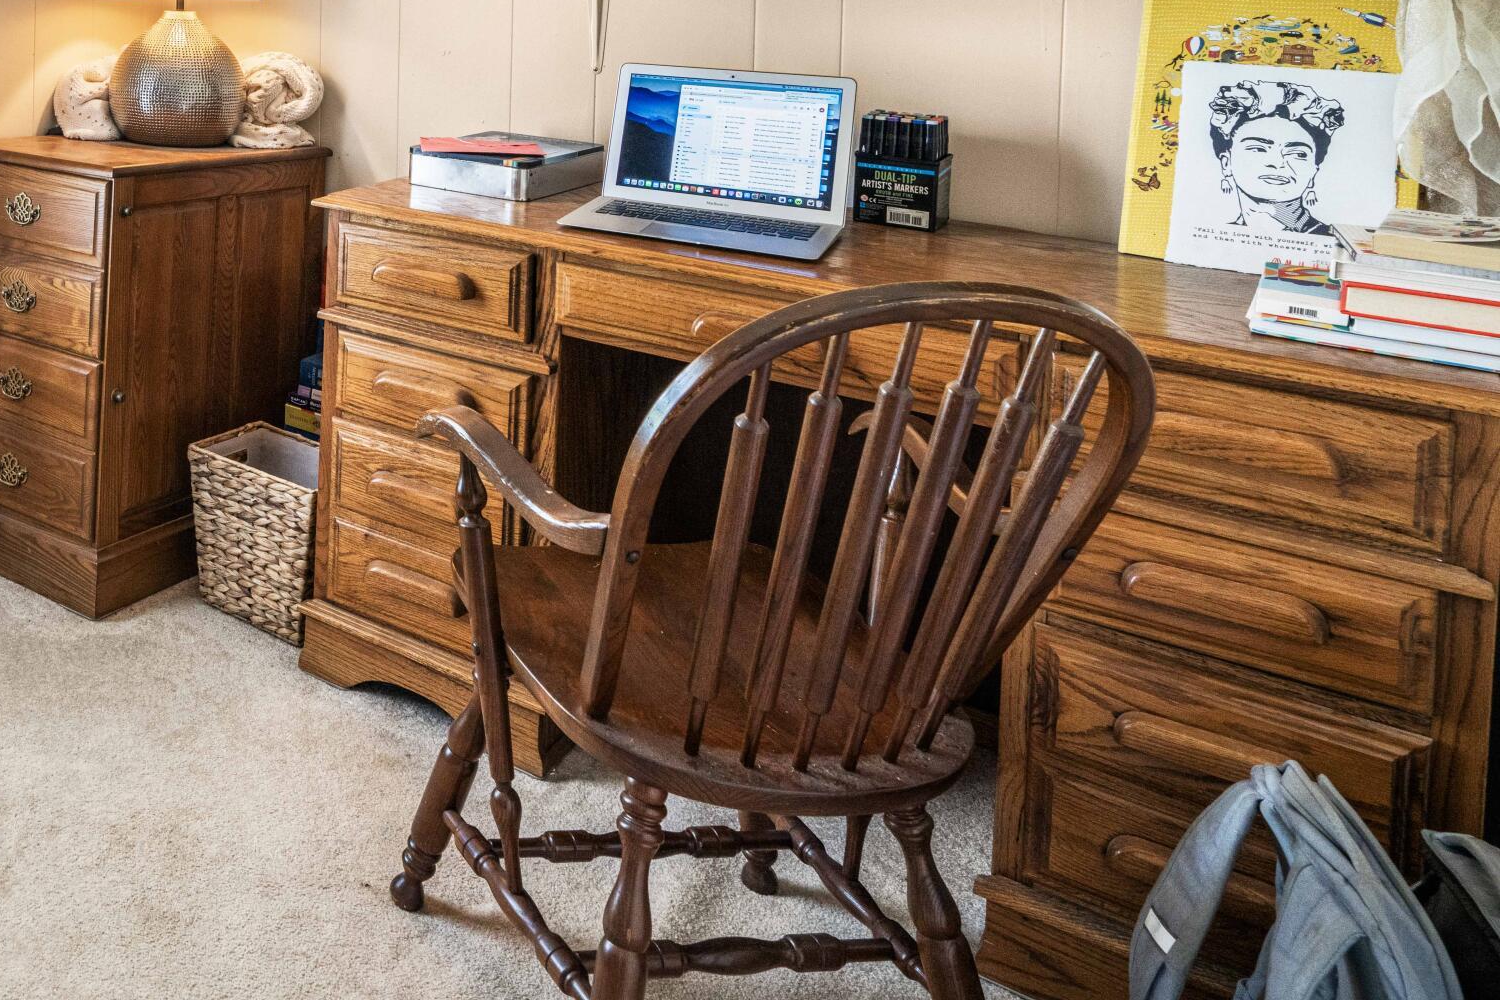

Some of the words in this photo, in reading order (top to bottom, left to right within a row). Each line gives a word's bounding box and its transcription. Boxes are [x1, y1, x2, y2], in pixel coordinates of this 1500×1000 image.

[874, 170, 917, 185] DUAL-TIP
[861, 179, 892, 191] ARTIST'S
[894, 182, 929, 195] MARKERS
[1214, 235, 1235, 243] then
